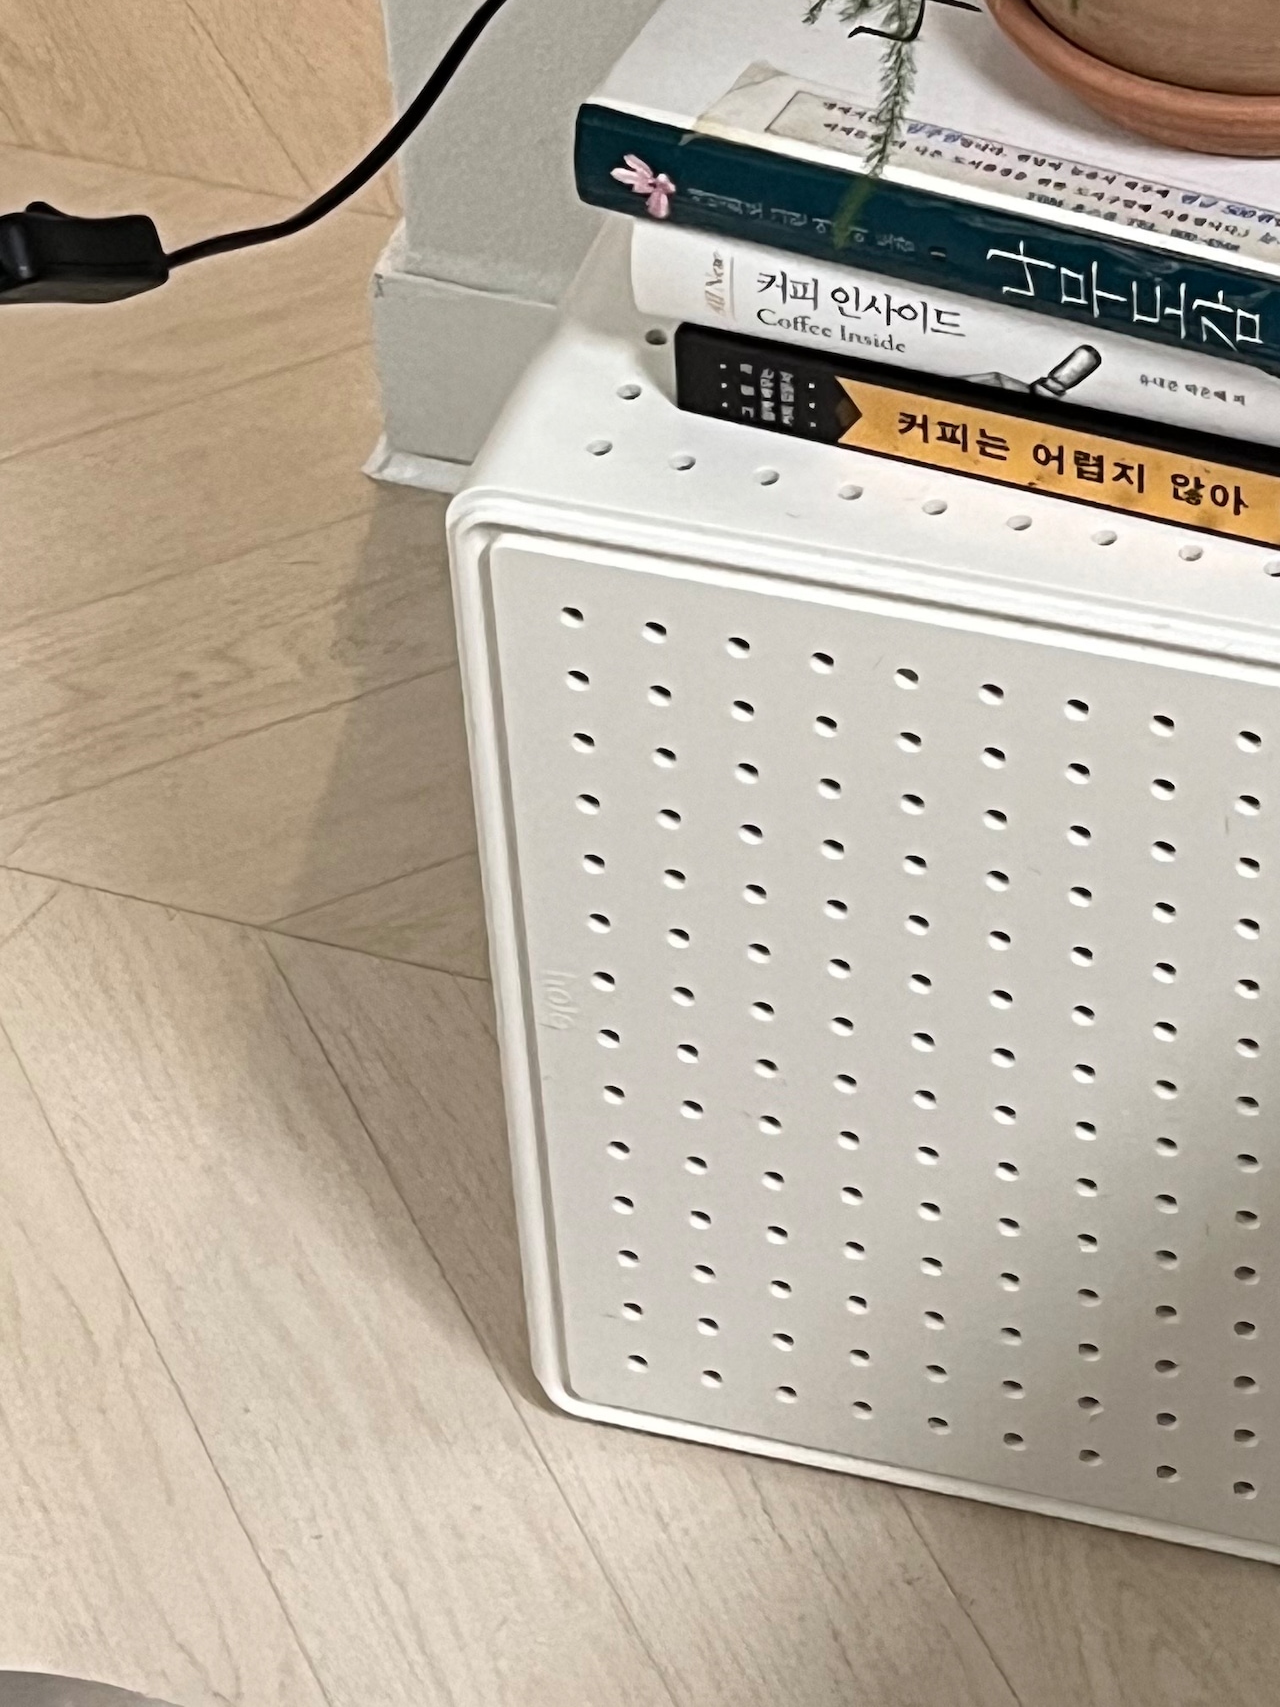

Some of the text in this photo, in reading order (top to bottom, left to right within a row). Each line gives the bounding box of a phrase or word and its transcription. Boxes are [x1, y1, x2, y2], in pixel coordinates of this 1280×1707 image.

[756, 308, 906, 354] Coffee Inside
[757, 270, 966, 338] 커피 인사이드
[898, 412, 1250, 516] 커피는 어렵지 않아
